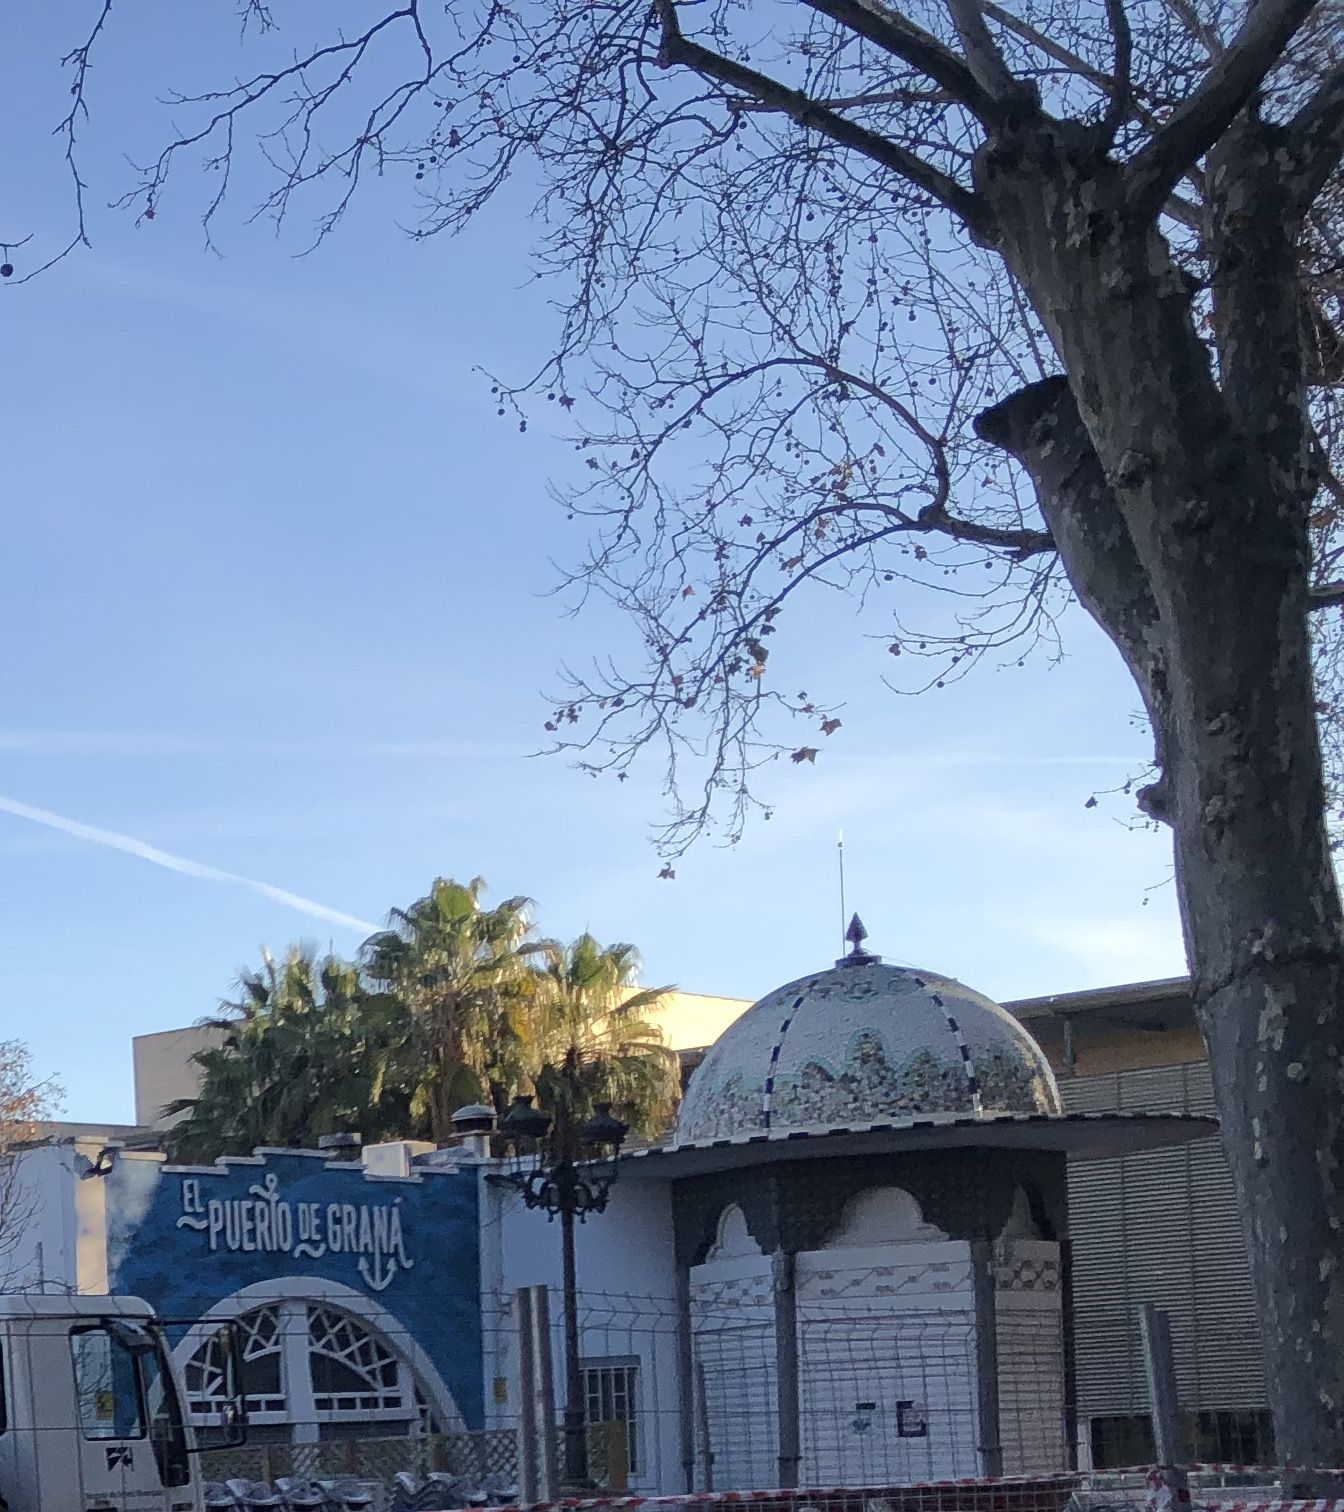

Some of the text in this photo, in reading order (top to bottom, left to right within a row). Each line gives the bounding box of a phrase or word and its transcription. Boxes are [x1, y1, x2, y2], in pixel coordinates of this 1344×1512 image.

[182, 1179, 205, 1213] EL
[208, 1190, 292, 1251] PUERTO
[298, 1203, 322, 1241] DE
